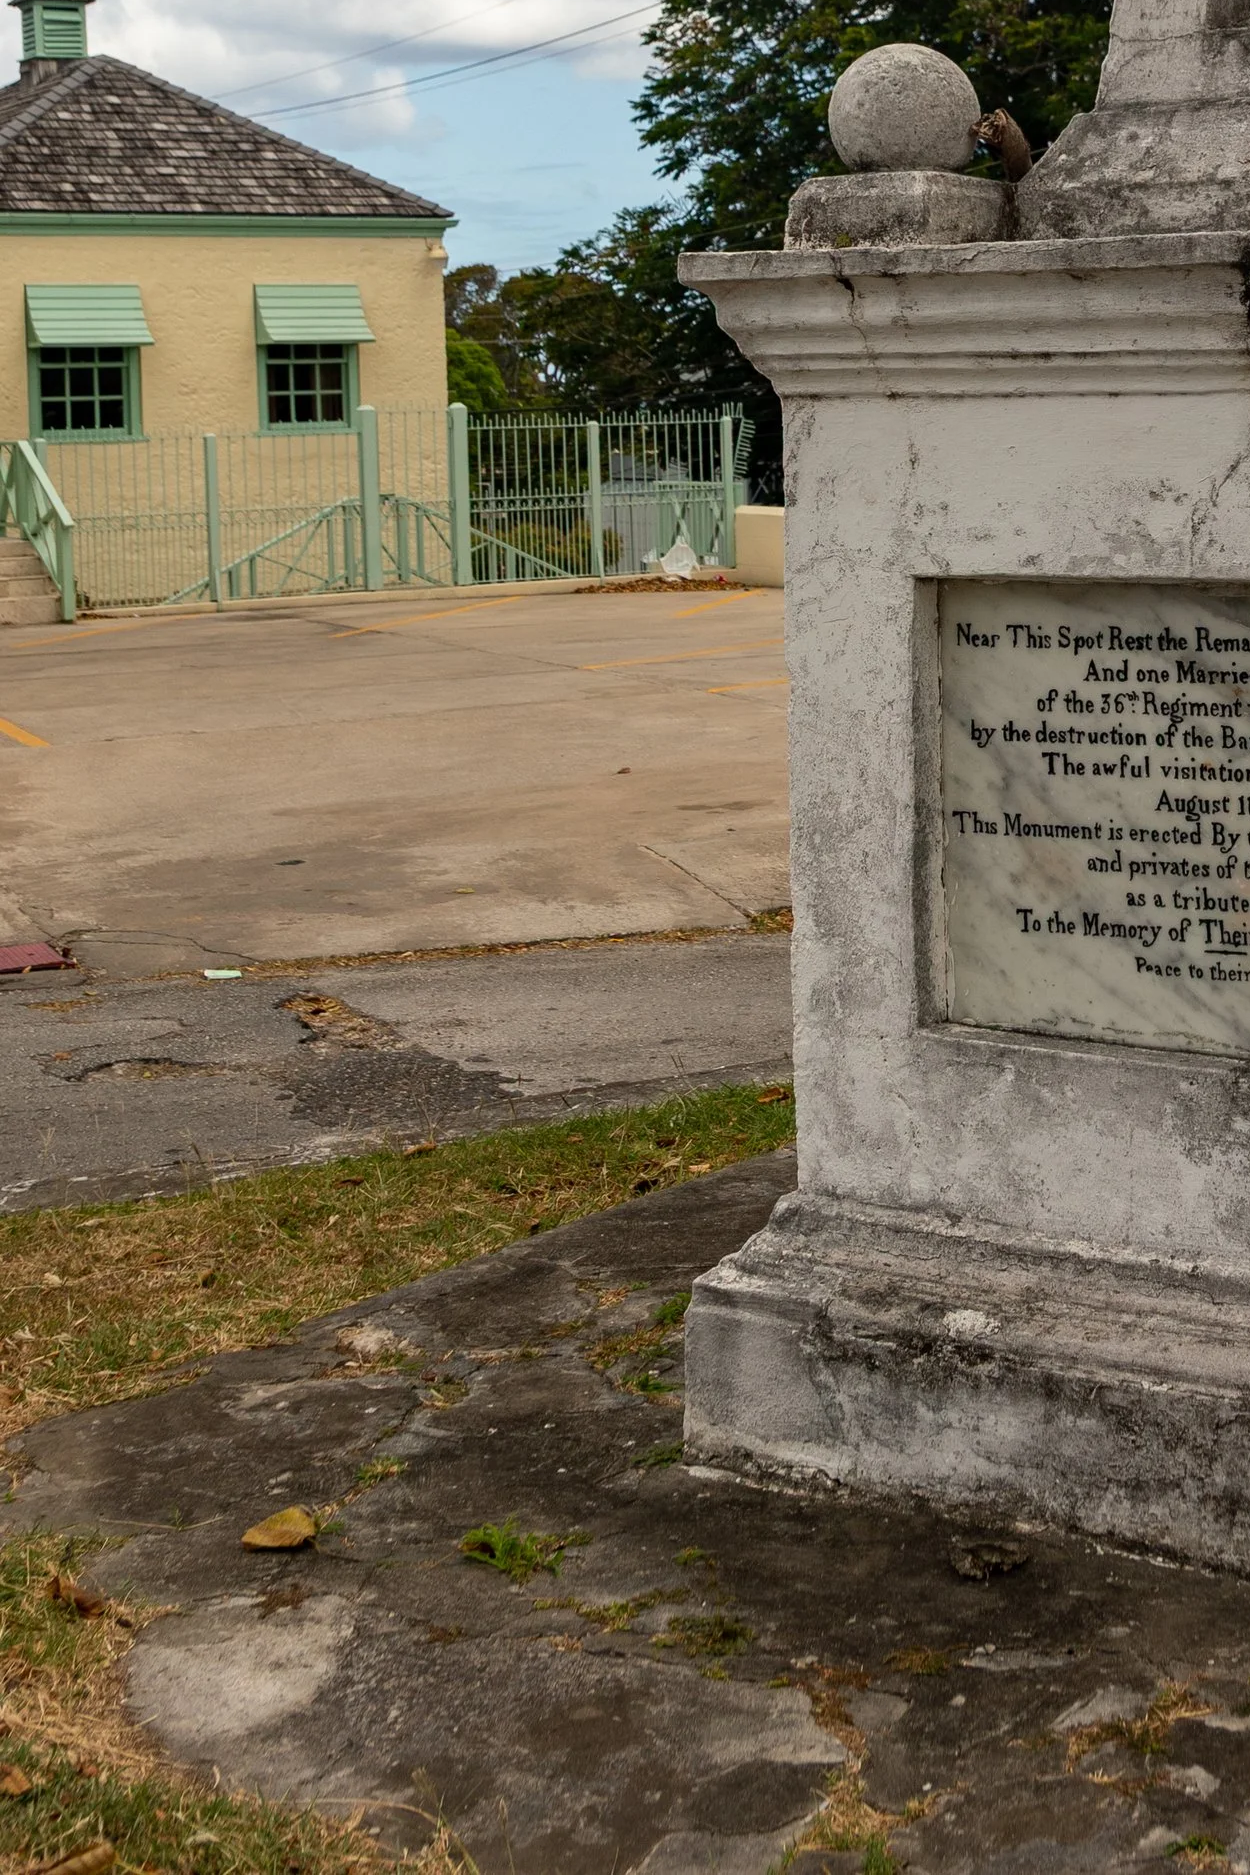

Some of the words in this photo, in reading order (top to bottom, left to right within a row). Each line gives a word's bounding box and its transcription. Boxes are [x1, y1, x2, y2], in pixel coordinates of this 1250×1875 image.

[956, 623, 1000, 648] Near
[1006, 625, 1051, 649] This
[1058, 626, 1103, 656] Spot
[1108, 626, 1153, 651] Rest
[1156, 627, 1188, 651] the
[1083, 659, 1128, 682] And
[1137, 666, 1169, 682] one
[1037, 689, 1058, 712] of
[1063, 690, 1094, 713] the
[1142, 691, 1242, 723] Regiment
[970, 720, 996, 748] by
[1002, 721, 1031, 742] the
[1036, 721, 1146, 746] destruction
[1155, 723, 1178, 748] of
[1182, 725, 1214, 748] the
[1042, 752, 1085, 775] The
[1092, 755, 1150, 778] awful
[1155, 790, 1230, 822] August
[952, 811, 997, 835] This
[1003, 813, 1102, 840] Monument
[1108, 820, 1123, 840] is
[1129, 823, 1201, 844] erected
[1211, 823, 1240, 853] By
[1088, 850, 1122, 873] and
[1129, 853, 1210, 880] privates
[1216, 855, 1238, 878] of
[1126, 891, 1146, 907] as
[1154, 893, 1165, 908] a
[1173, 887, 1249, 912] tribute
[1016, 909, 1041, 932] To
[1048, 911, 1076, 934] the
[1082, 912, 1162, 947] Memory
[1169, 919, 1192, 942] of
[1135, 957, 1181, 977] Peace
[1188, 963, 1203, 978] to
